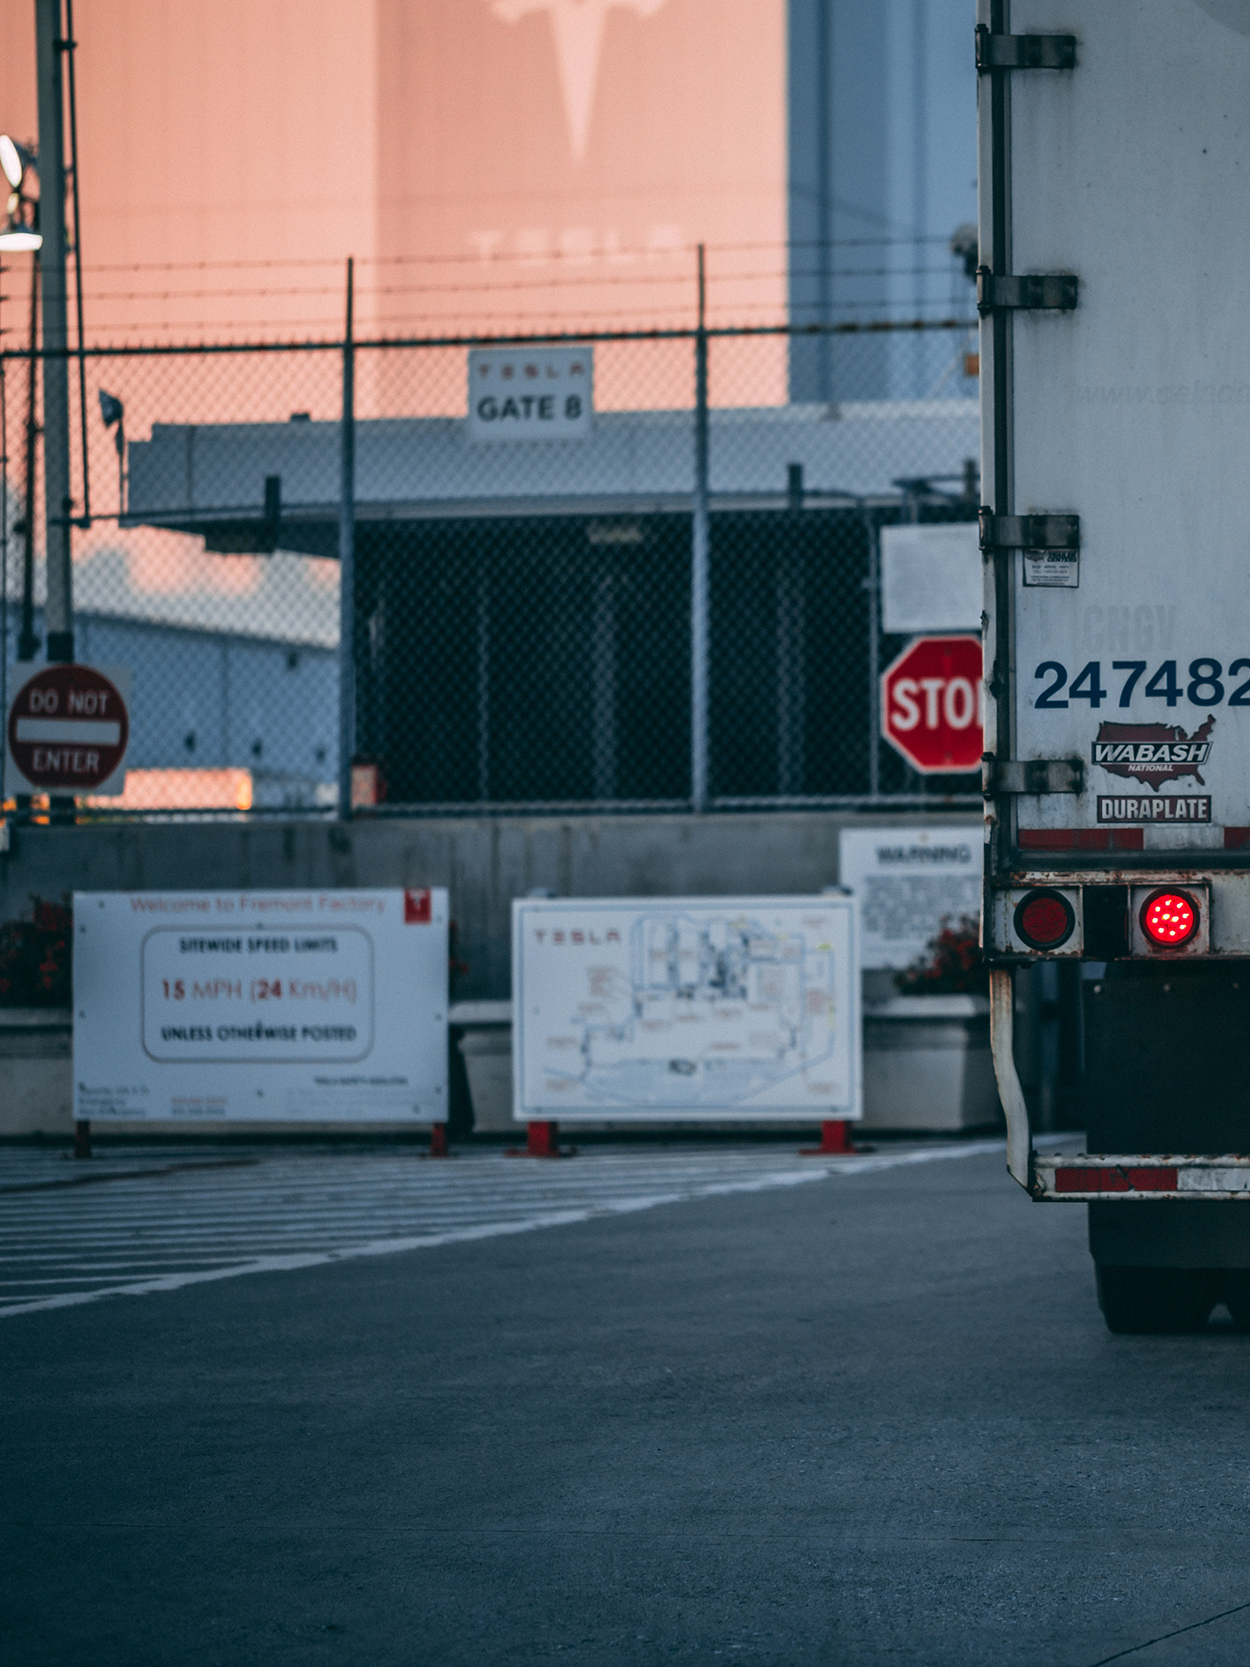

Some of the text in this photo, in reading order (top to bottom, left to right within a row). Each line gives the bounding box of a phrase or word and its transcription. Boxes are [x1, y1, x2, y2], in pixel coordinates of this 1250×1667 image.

[477, 362, 585, 379] TESLA
[476, 394, 582, 422] GATE 8
[29, 688, 109, 715] DO NOT
[890, 677, 983, 730] STO
[33, 748, 100, 773] ENTER
[1095, 744, 1208, 761] WABASH
[1101, 799, 1208, 819] DURAPLATE
[876, 845, 972, 863] WARNING
[131, 896, 386, 914] Welcome to Fremont Factory
[179, 937, 338, 953] SITEWIDE SPEED LIMITS
[534, 929, 621, 945] TESLA
[162, 979, 186, 1000] 15
[192, 980, 241, 999] MPH
[249, 979, 282, 1003] (24
[160, 1025, 357, 1041] UNLESS OTHERWISE POSTED
